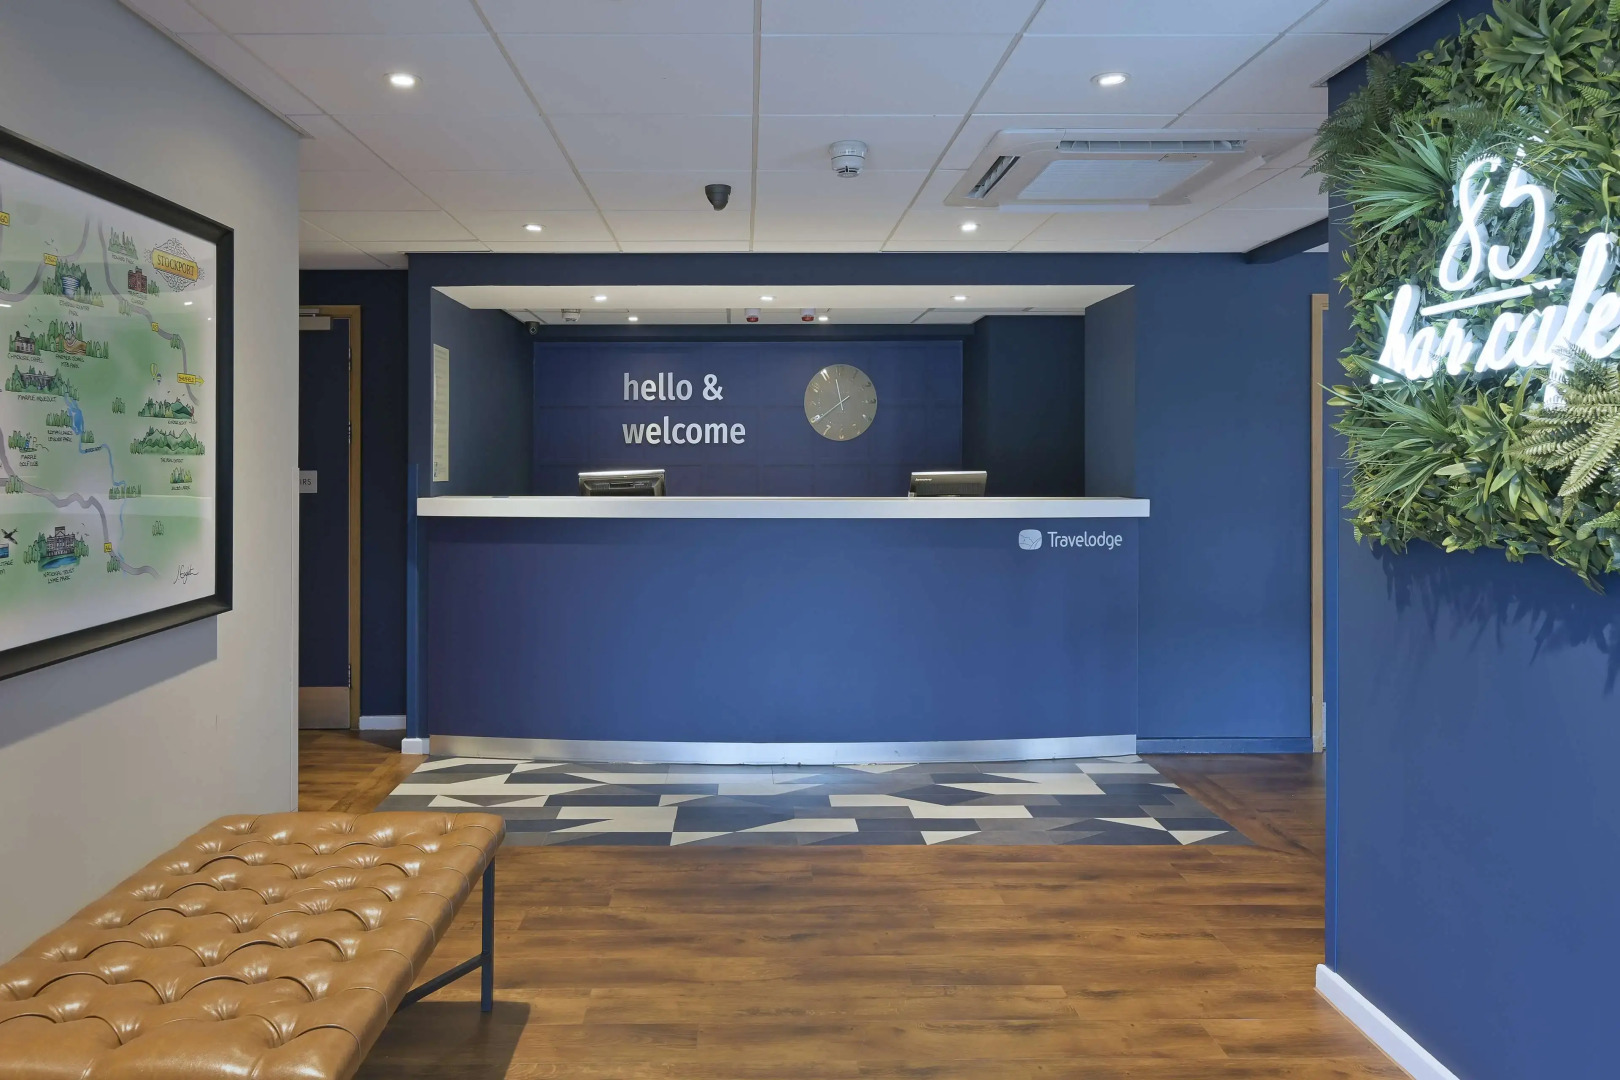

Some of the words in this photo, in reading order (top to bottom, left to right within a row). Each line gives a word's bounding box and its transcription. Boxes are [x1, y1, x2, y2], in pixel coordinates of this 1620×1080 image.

[1439, 139, 1547, 291] 85
[157, 254, 195, 277] STOCKPORT
[1370, 284, 1475, 384] bar
[623, 371, 693, 401] hello
[702, 373, 724, 401] &
[622, 415, 746, 445] welcome
[1047, 530, 1123, 550] Travelodge
